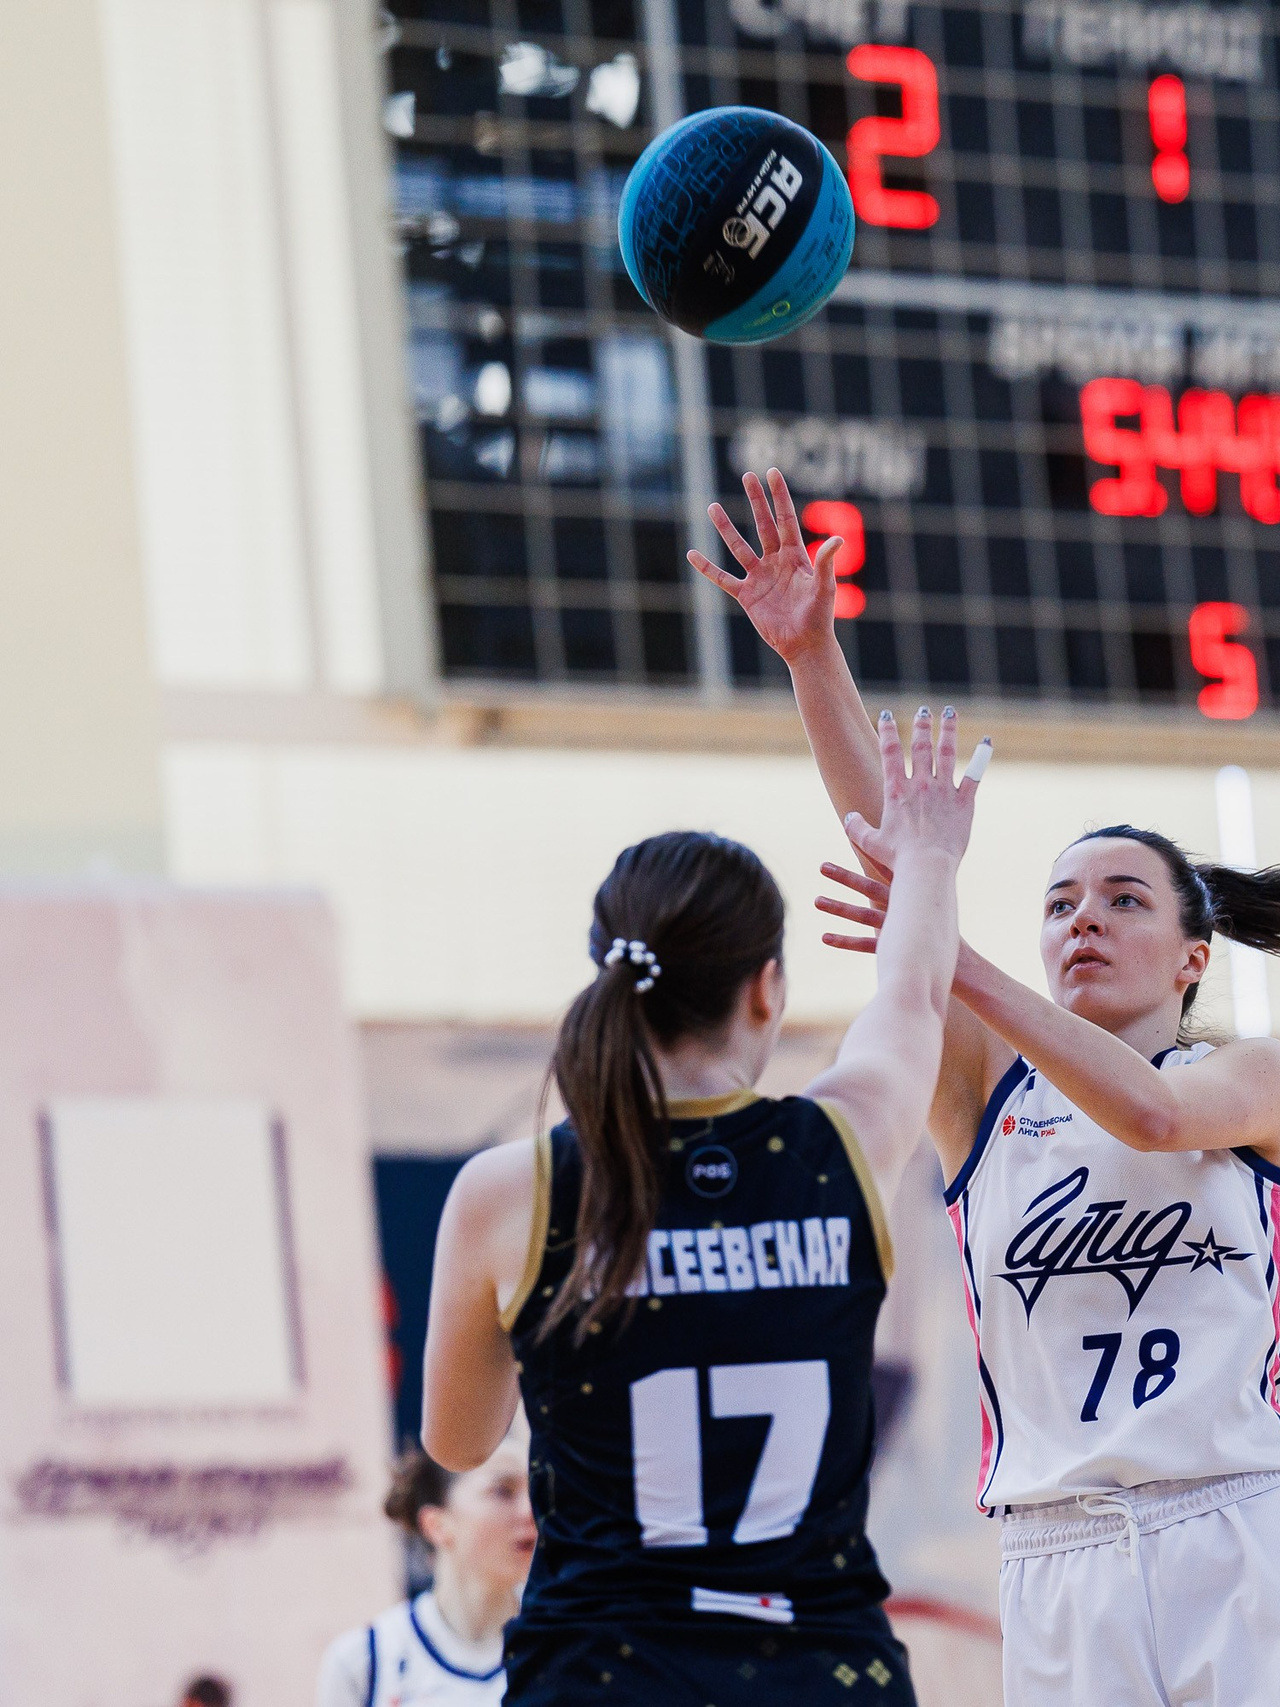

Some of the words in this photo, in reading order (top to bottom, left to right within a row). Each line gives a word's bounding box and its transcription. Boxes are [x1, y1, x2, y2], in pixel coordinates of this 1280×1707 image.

[846, 44, 941, 230] 2
[1189, 602, 1258, 720] 5
[1017, 1127, 1039, 1138] ЛИГА
[1019, 1114, 1073, 1129] СТУДЕНЧЕСКАЯ
[1079, 1328, 1181, 1423] 78
[630, 1360, 831, 1548] 17
